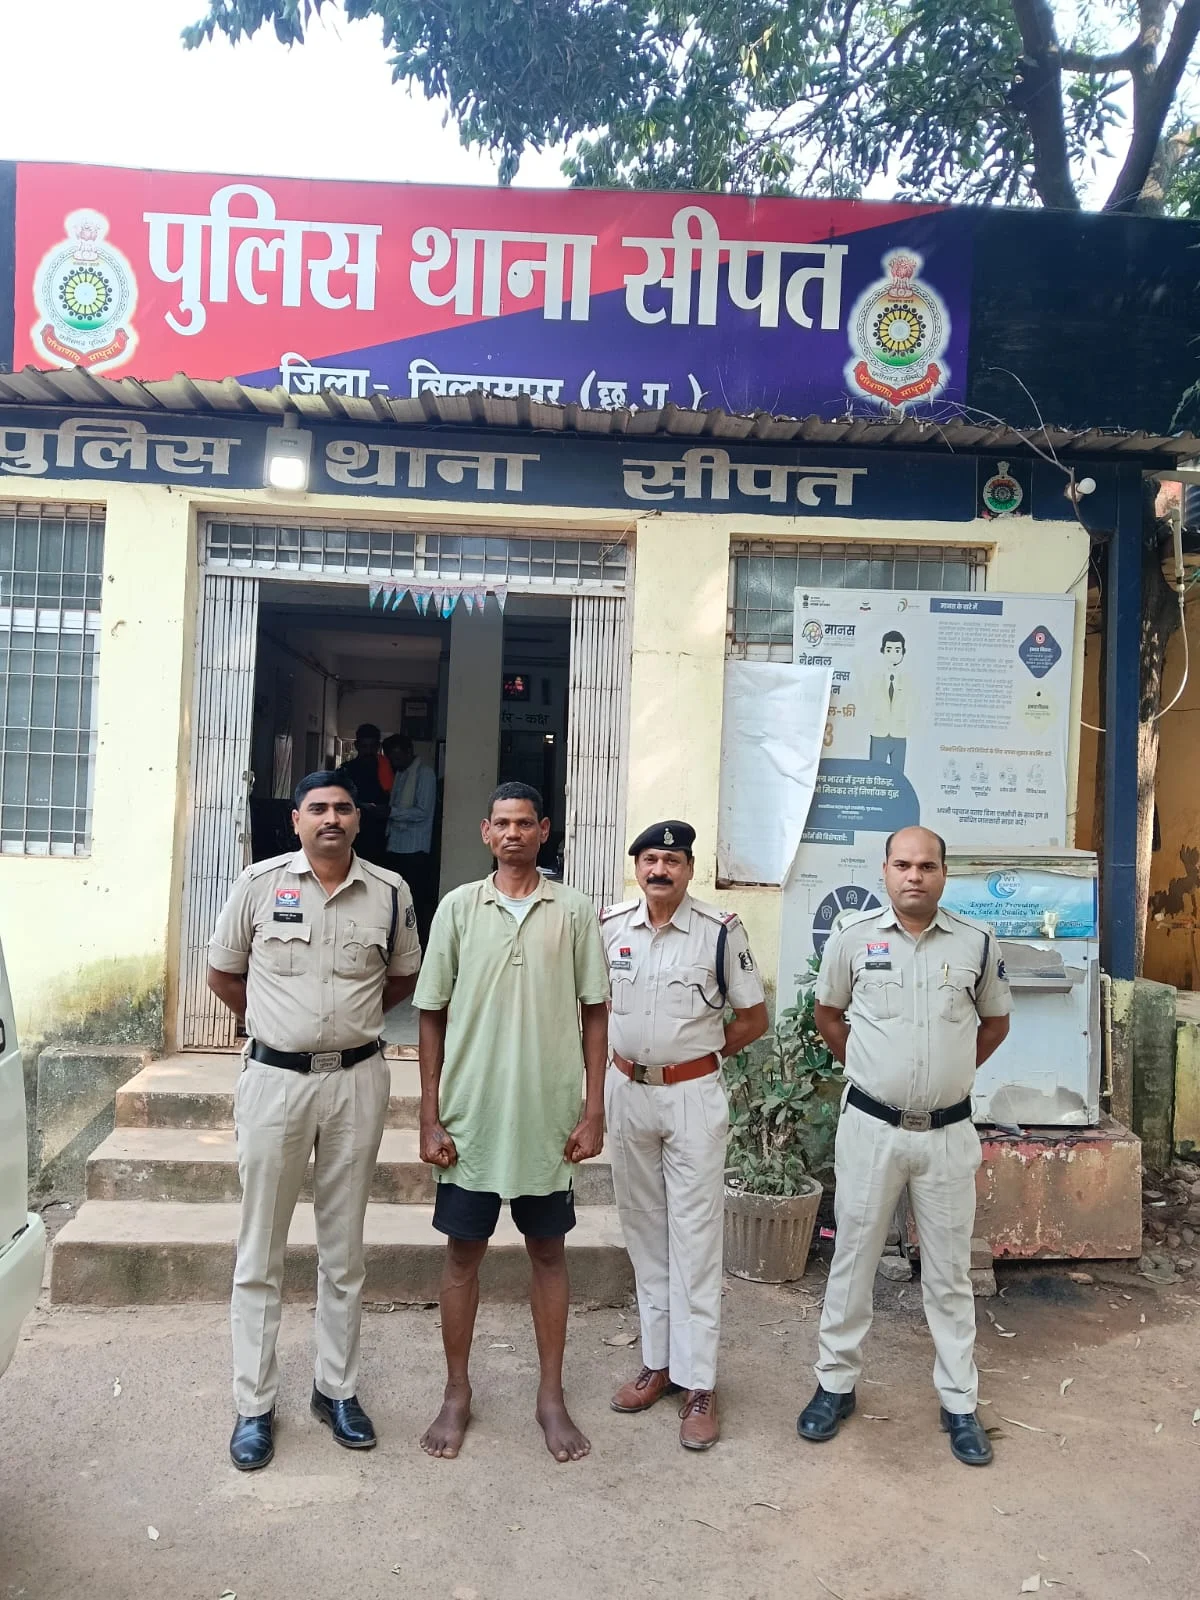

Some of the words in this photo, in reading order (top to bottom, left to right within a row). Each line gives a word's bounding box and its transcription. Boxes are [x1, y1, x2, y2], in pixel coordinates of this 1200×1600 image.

[143, 184, 382, 336] पुलिस
[410, 226, 598, 322] थाना
[622, 205, 848, 331] सीपत
[408, 358, 565, 406] बिलासपर
[0, 417, 242, 476] पुलिस
[325, 439, 541, 491] थाना
[622, 448, 868, 507] सीपत
[824, 623, 857, 636] मानस
[799, 652, 832, 666] नेशनल
[828, 703, 857, 718] ल-फ्री
[969, 901, 994, 909] Expert
[1005, 901, 1040, 909] Providing
[1001, 909, 1028, 917] Quality
